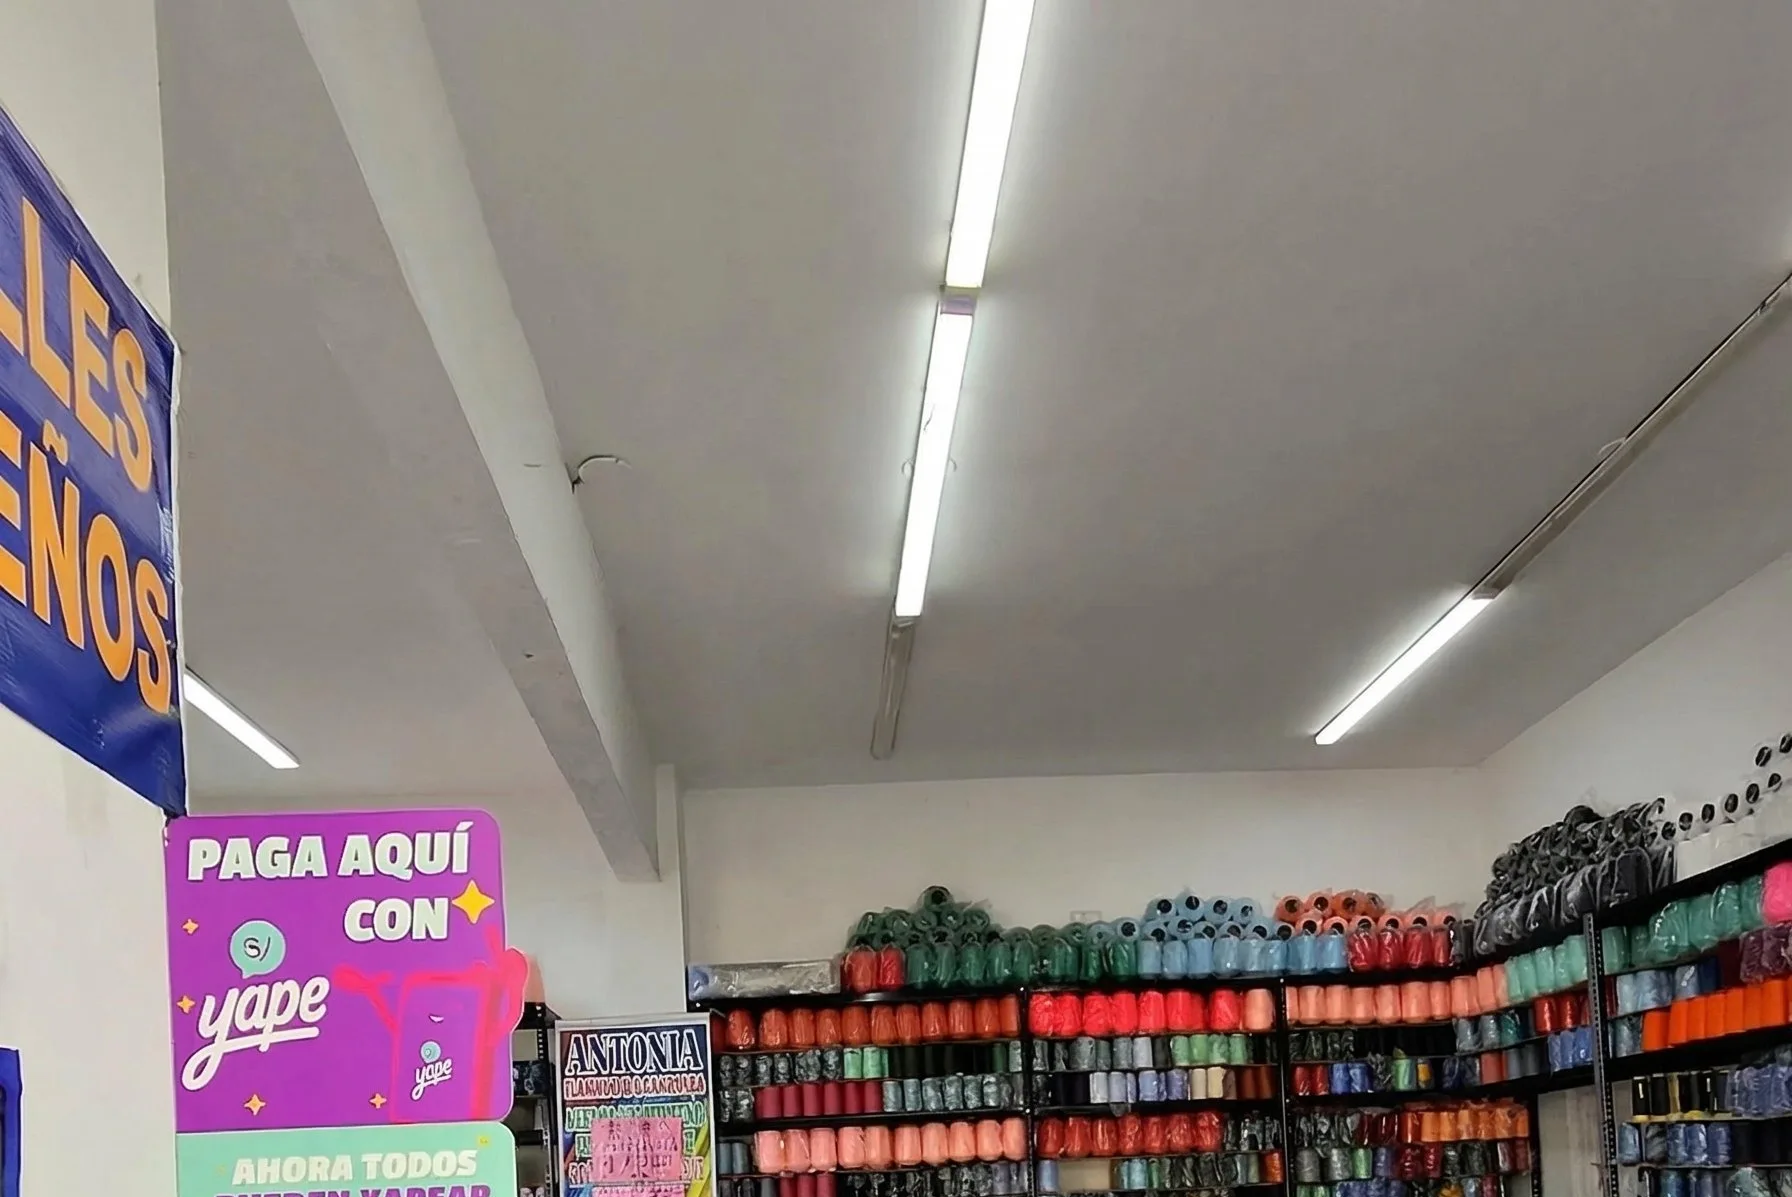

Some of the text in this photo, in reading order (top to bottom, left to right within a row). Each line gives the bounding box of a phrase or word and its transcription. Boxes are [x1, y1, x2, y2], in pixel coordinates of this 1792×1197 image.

[187, 821, 474, 881] PAGA AQUÍ
[343, 897, 449, 942] CON
[181, 976, 330, 1091] yape
[565, 1029, 704, 1075] ANTONIA
[411, 1058, 453, 1100] yape
[232, 1149, 479, 1186] AHORA TODOS
